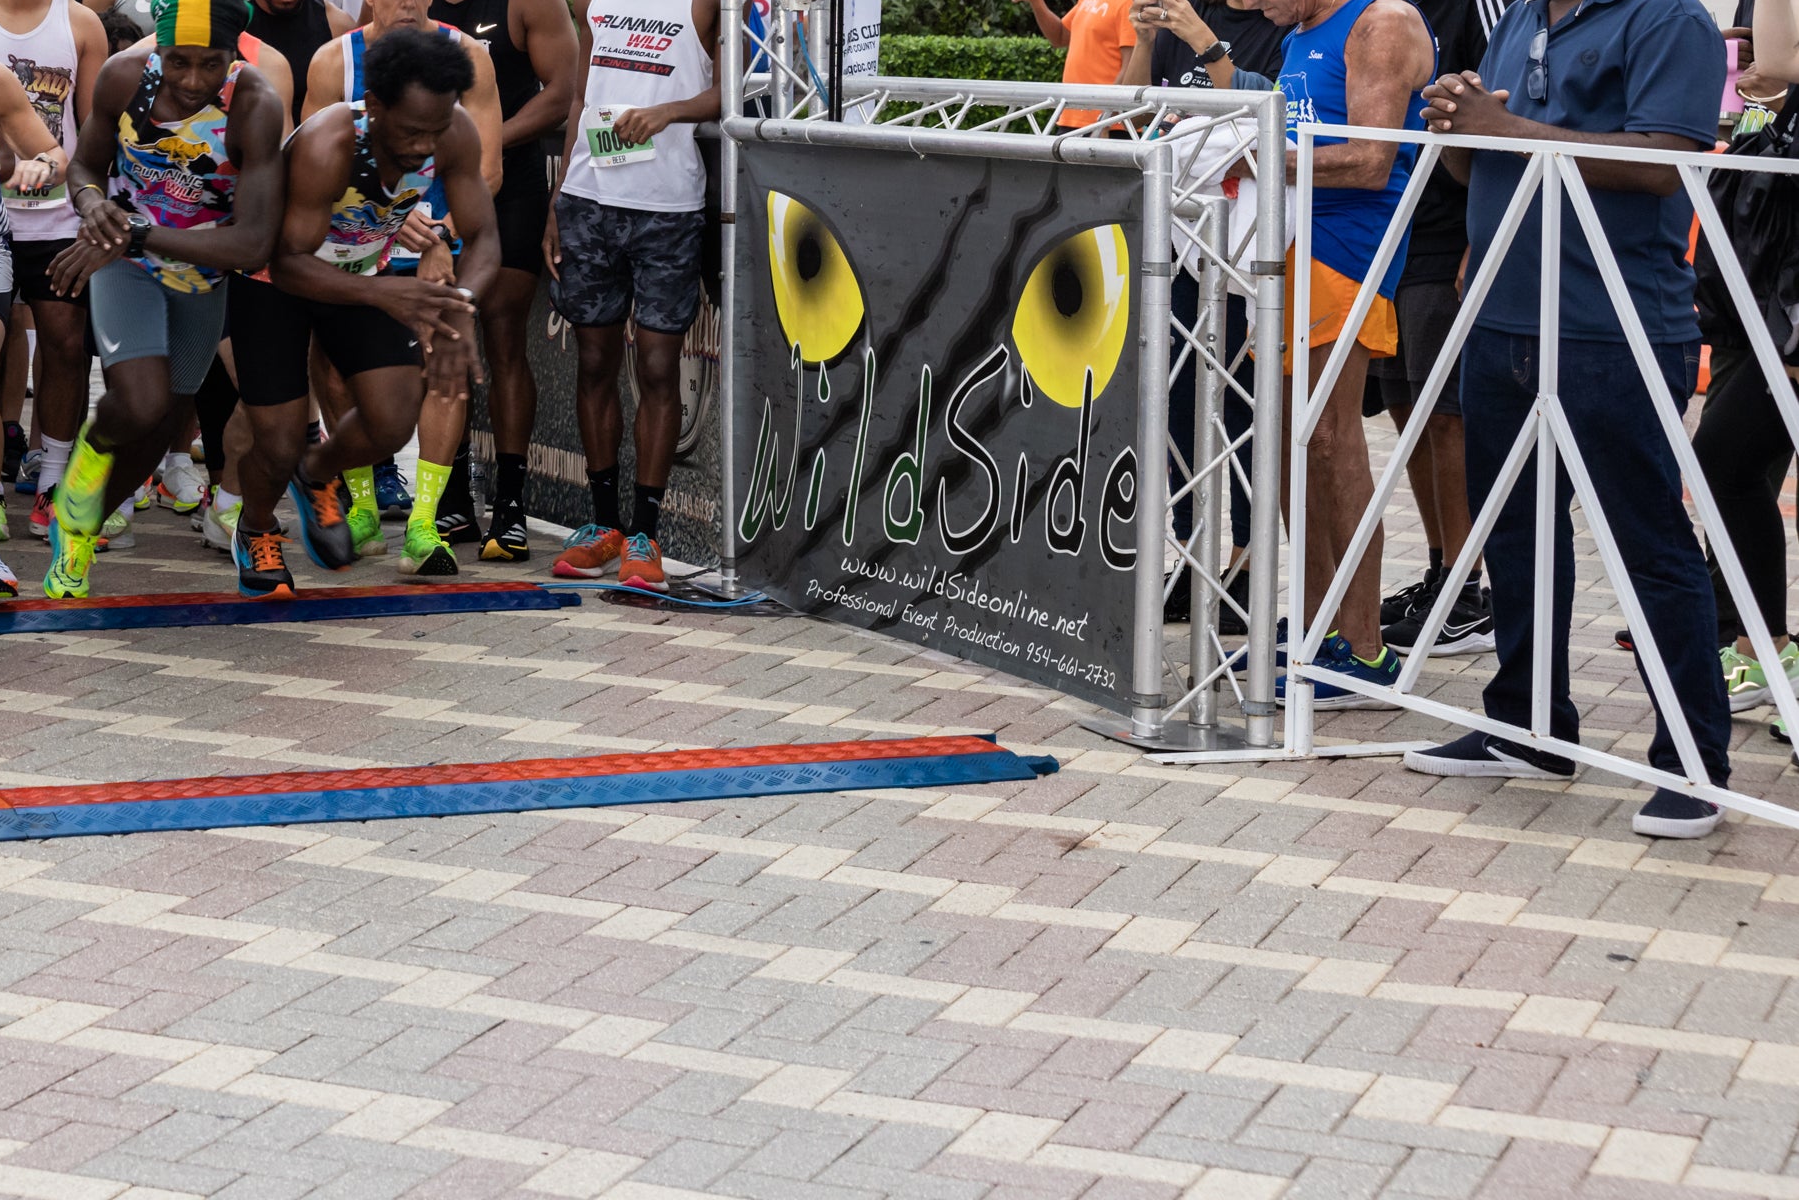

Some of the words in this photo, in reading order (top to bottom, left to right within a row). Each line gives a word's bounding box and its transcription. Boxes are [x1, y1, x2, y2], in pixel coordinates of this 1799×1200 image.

[598, 14, 684, 37] RUNNING
[626, 34, 672, 51] WILD
[853, 41, 876, 53] COUNTY
[608, 47, 661, 60] LAUDERDALE
[634, 62, 670, 75] TEAM
[612, 155, 626, 164] BEER
[738, 340, 1138, 571] WildSide
[840, 556, 1088, 642] www.wildSideonline.net
[805, 579, 898, 621] Professional
[901, 603, 939, 633] Event
[944, 614, 1020, 657] Production
[1025, 641, 1116, 691] 954-661-2732
